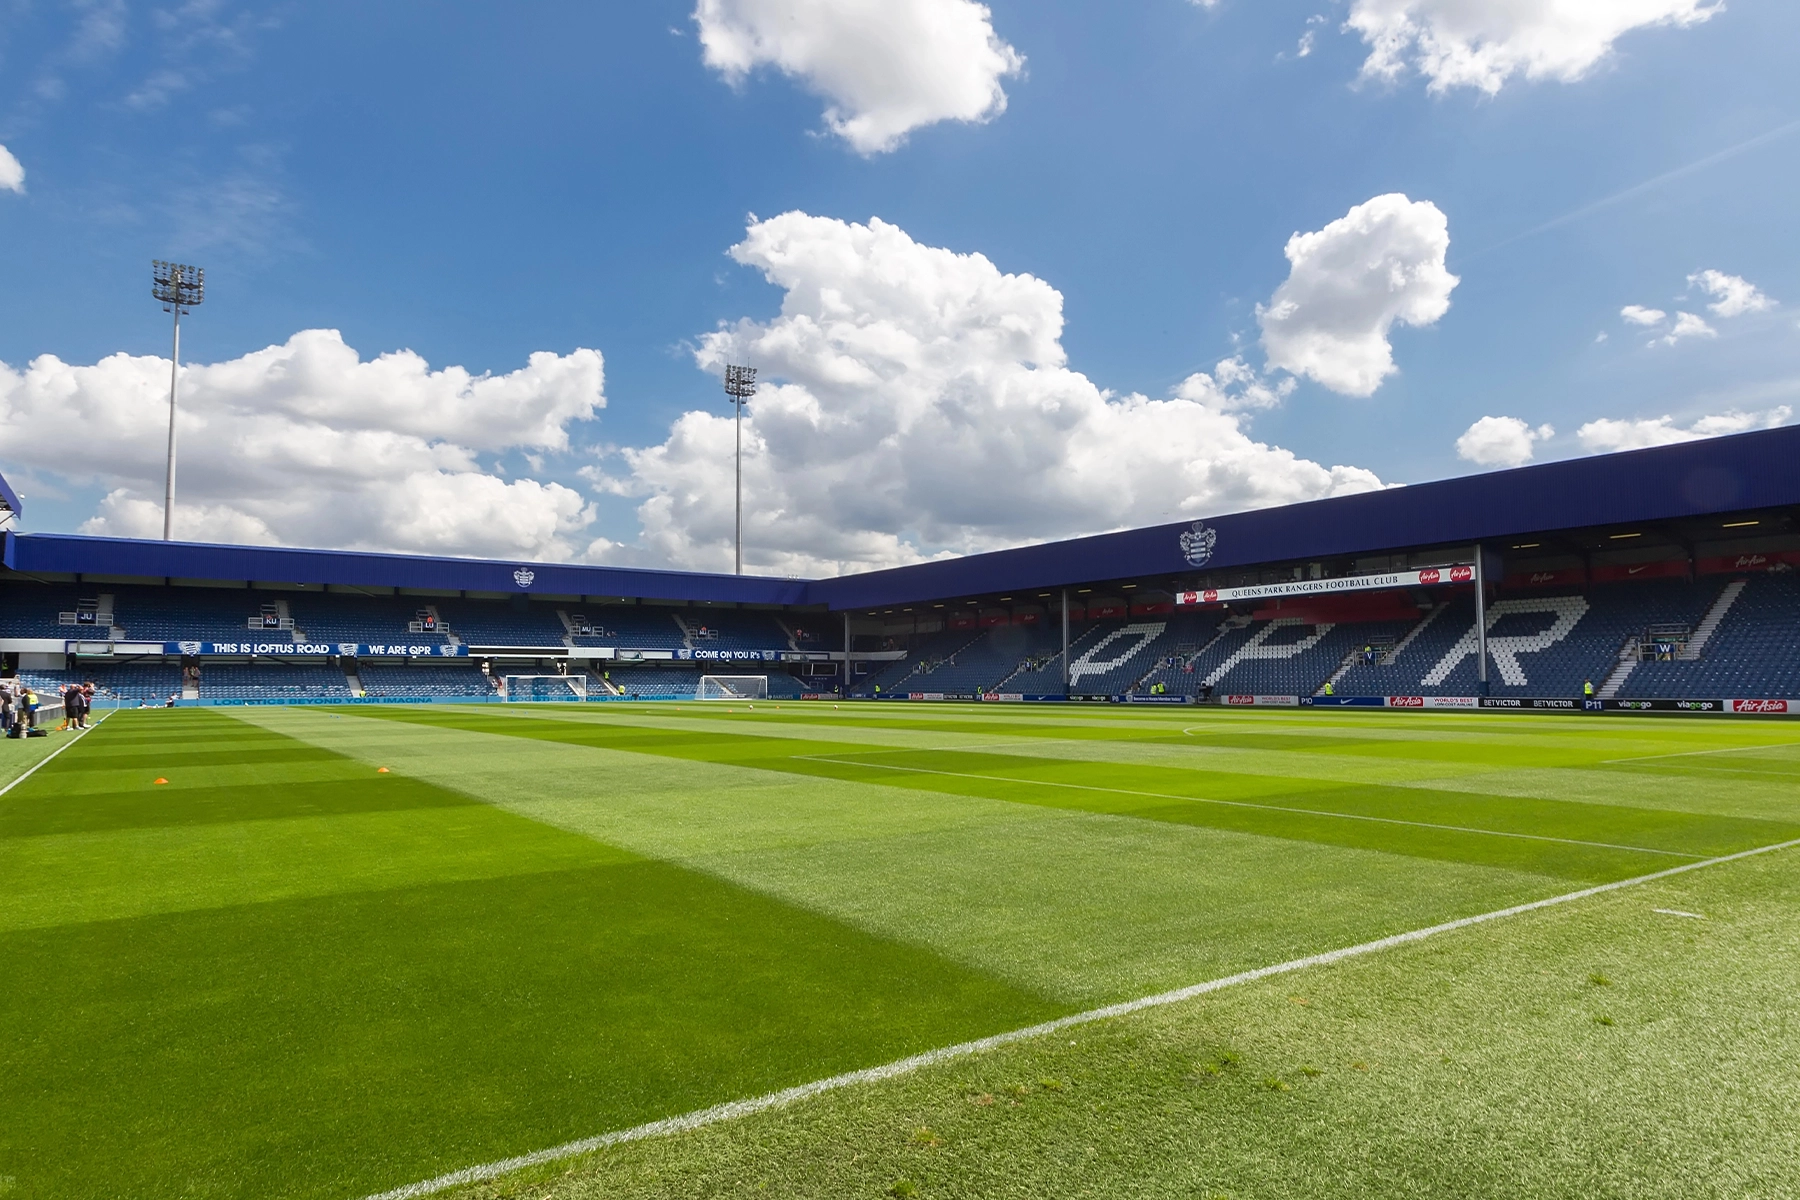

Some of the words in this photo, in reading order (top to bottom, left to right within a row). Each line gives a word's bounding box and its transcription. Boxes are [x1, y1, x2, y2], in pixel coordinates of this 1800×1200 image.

[1232, 589, 1262, 598] QUEENS
[1264, 586, 1283, 595] PARK
[1285, 582, 1323, 592] RANGERS
[1325, 577, 1370, 590] FOOTBALL
[1373, 575, 1398, 585] CLUB
[1420, 595, 1591, 687] R
[212, 643, 238, 653] THIS
[240, 643, 251, 653] IS
[253, 643, 294, 654] LOFTUS
[297, 644, 330, 654] ROAD
[369, 645, 385, 655] WE
[387, 645, 407, 655] ARE
[409, 646, 431, 656] QPR
[1659, 644, 1671, 653] W
[695, 650, 719, 659] COME
[720, 650, 732, 659] ON
[733, 651, 749, 659] YOU
[750, 651, 760, 659] R's
[1301, 697, 1313, 705] P10
[1533, 700, 1574, 708] BETVICTOR
[1585, 701, 1602, 709] P11
[1618, 700, 1652, 709] viagogo
[1677, 700, 1713, 710] viagogo
[1736, 700, 1785, 711] AirAsia
